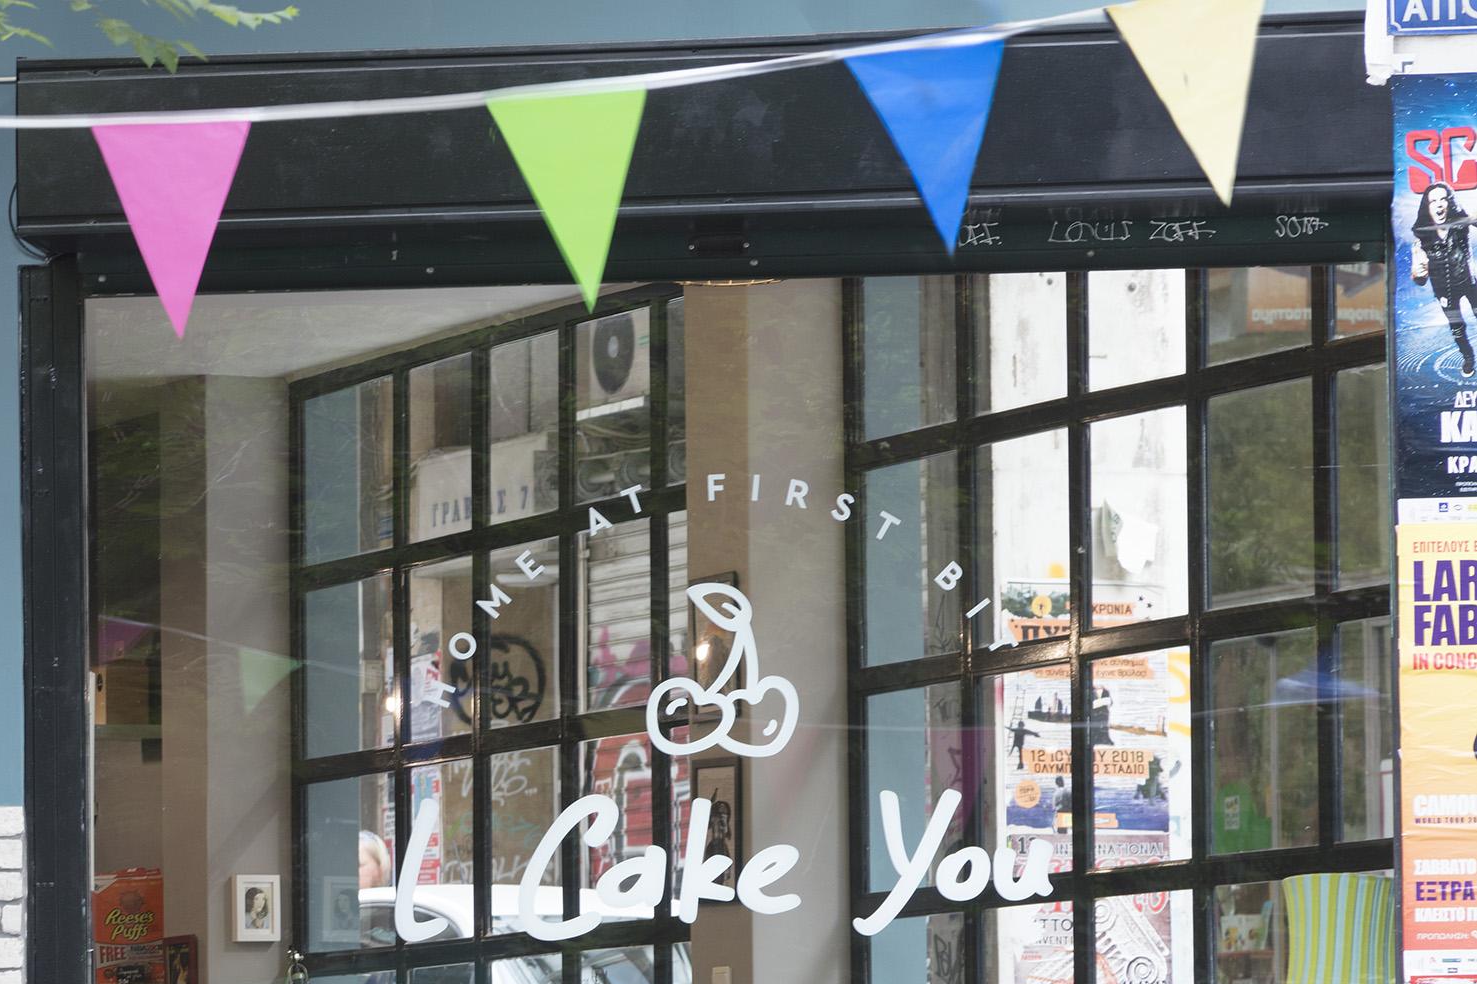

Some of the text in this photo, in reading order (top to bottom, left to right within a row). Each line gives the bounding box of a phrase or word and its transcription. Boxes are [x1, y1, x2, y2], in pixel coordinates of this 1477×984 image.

[432, 486, 529, 528] ΓΡΑΒΣ 7
[1413, 541, 1469, 554] ΕΠΙΤΕΛΟΥΣ
[423, 550, 545, 708] HOME
[588, 484, 643, 537] AT
[708, 473, 902, 541] FIRST
[1412, 653, 1429, 670] IN
[1031, 750, 1046, 762] 12
[1112, 751, 1144, 763] 2018
[1034, 763, 1145, 775] ΟΛΥΜΠΟ ΣΤΑΔΙΟ
[1055, 841, 1169, 858] INTNATIONAL
[519, 794, 801, 941] Cake
[852, 789, 1054, 936] You
[1414, 859, 1476, 876] ΣΑΒΒΑΤΟ
[105, 908, 155, 925] Reese's
[111, 923, 149, 941] Puffs
[99, 945, 126, 964] FREE
